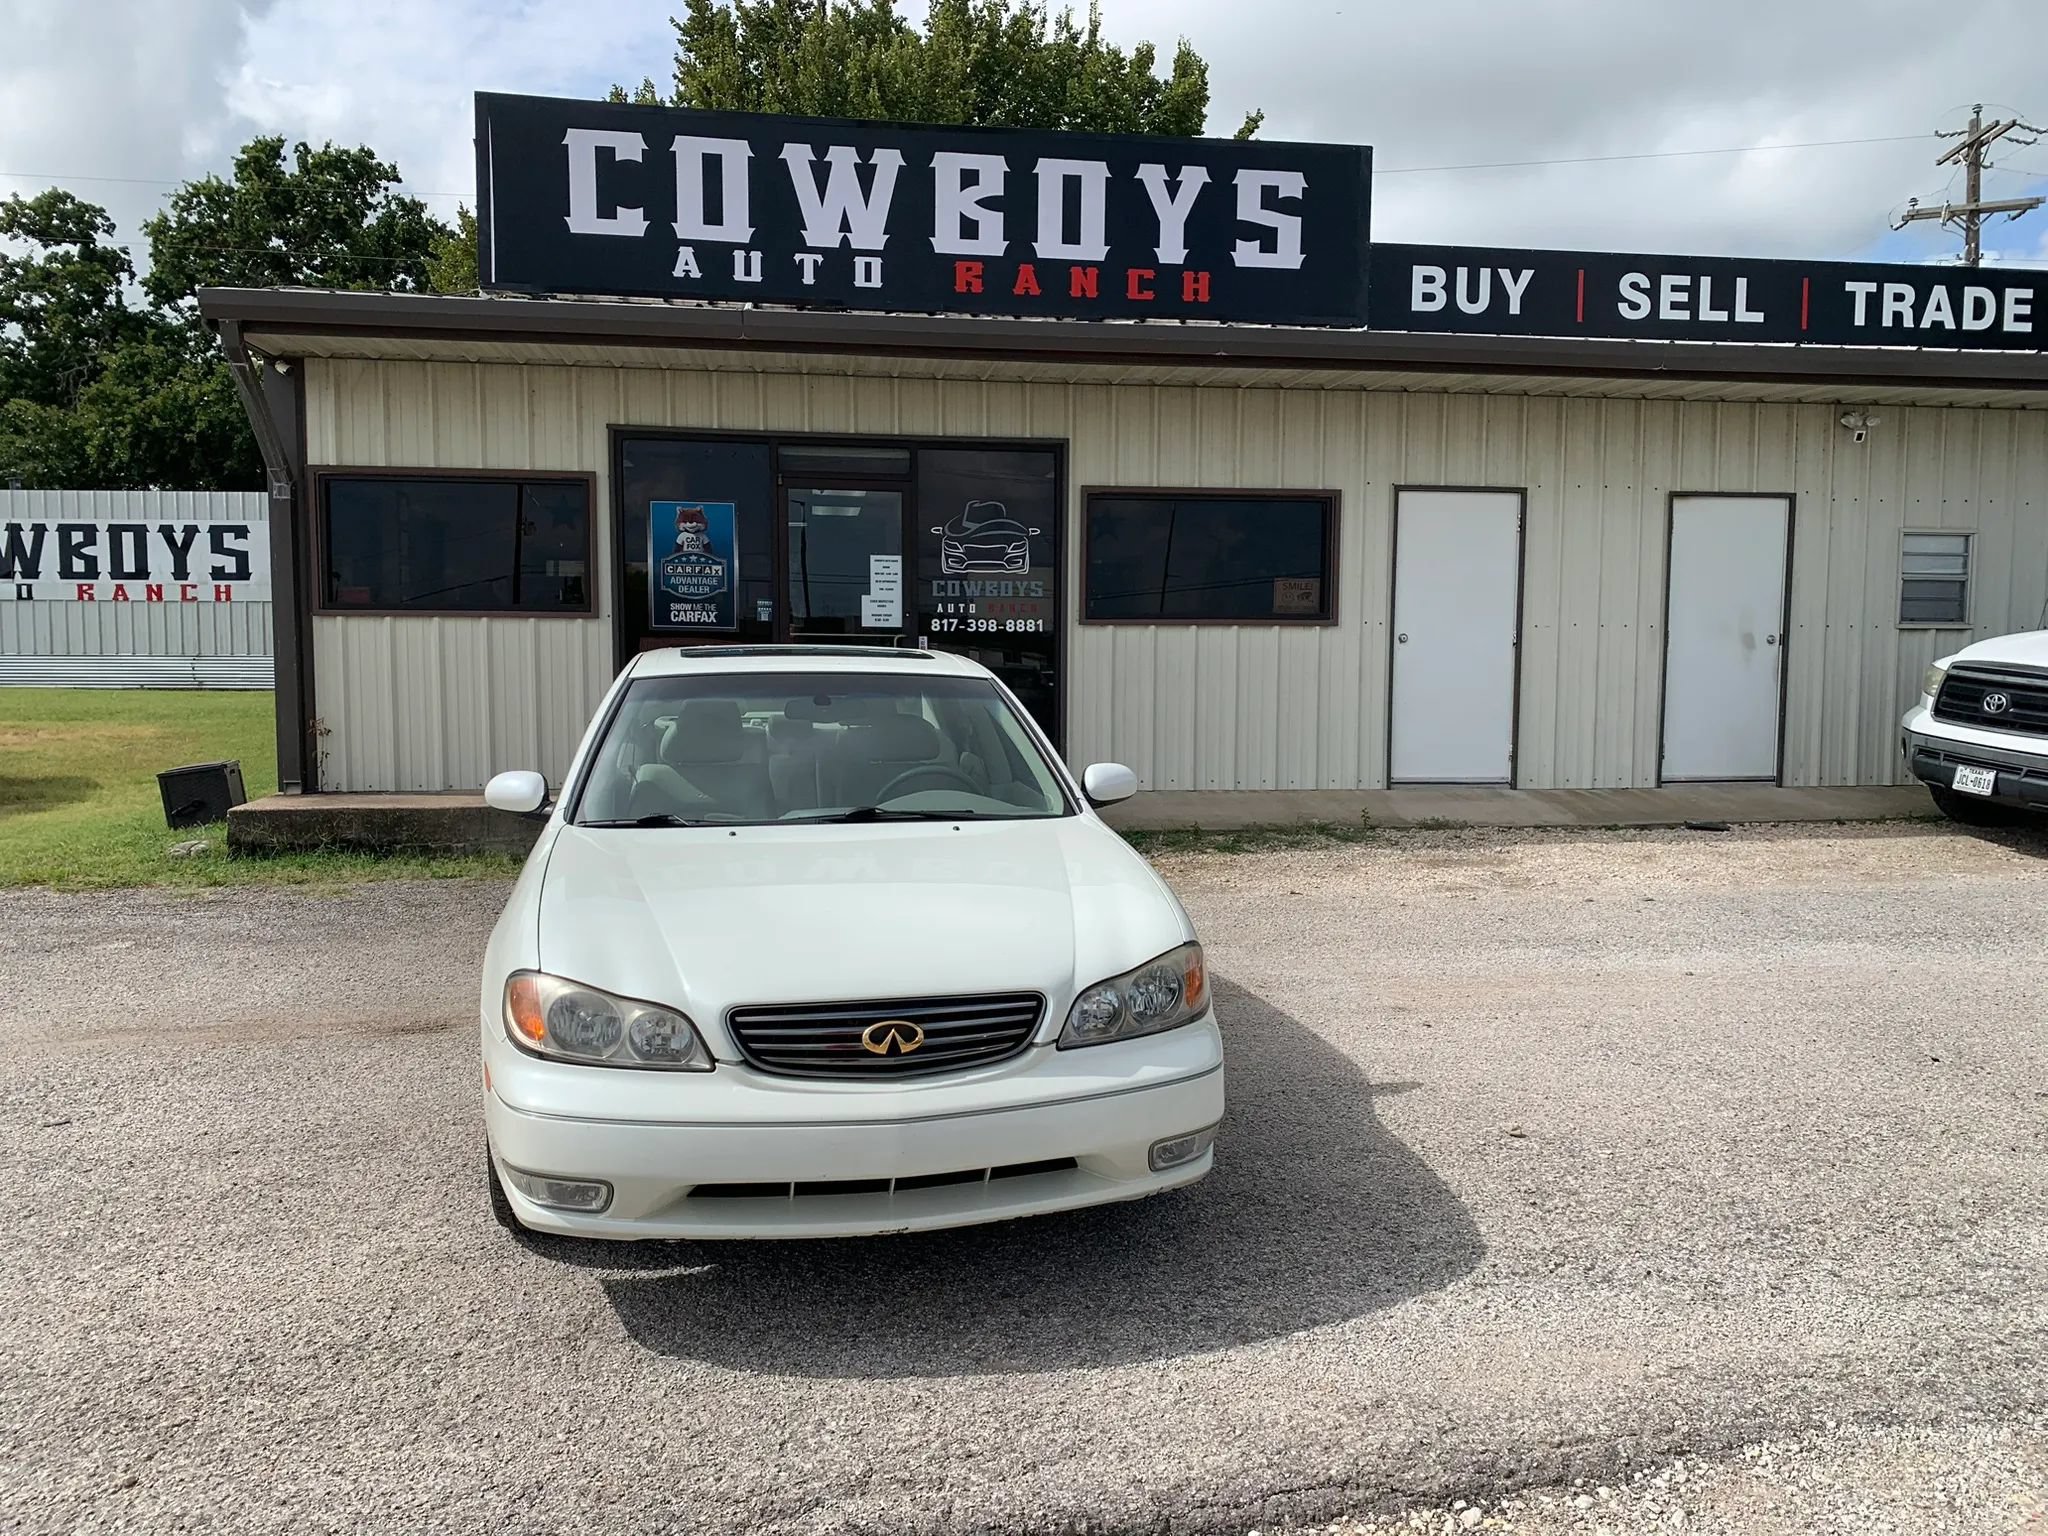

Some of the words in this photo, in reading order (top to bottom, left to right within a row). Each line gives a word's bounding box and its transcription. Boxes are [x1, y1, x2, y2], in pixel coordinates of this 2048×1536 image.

[561, 127, 1308, 270] COWBOYS
[672, 246, 884, 289] AUTO
[953, 260, 1211, 304] RANCH
[1411, 264, 1535, 315] BUY
[1617, 272, 1764, 324] SELL
[1845, 281, 2034, 333] TRADE
[666, 565, 721, 575] CARFAX
[670, 576, 718, 585] ADVANTAGE
[77, 583, 233, 601] RANCH
[678, 585, 710, 593] DEALER
[932, 580, 1043, 597] COWBOYS
[704, 603, 717, 611] THE
[937, 603, 976, 613] AUTO
[670, 611, 718, 622] CARFAX
[931, 618, 1043, 632] 817-398-8881
